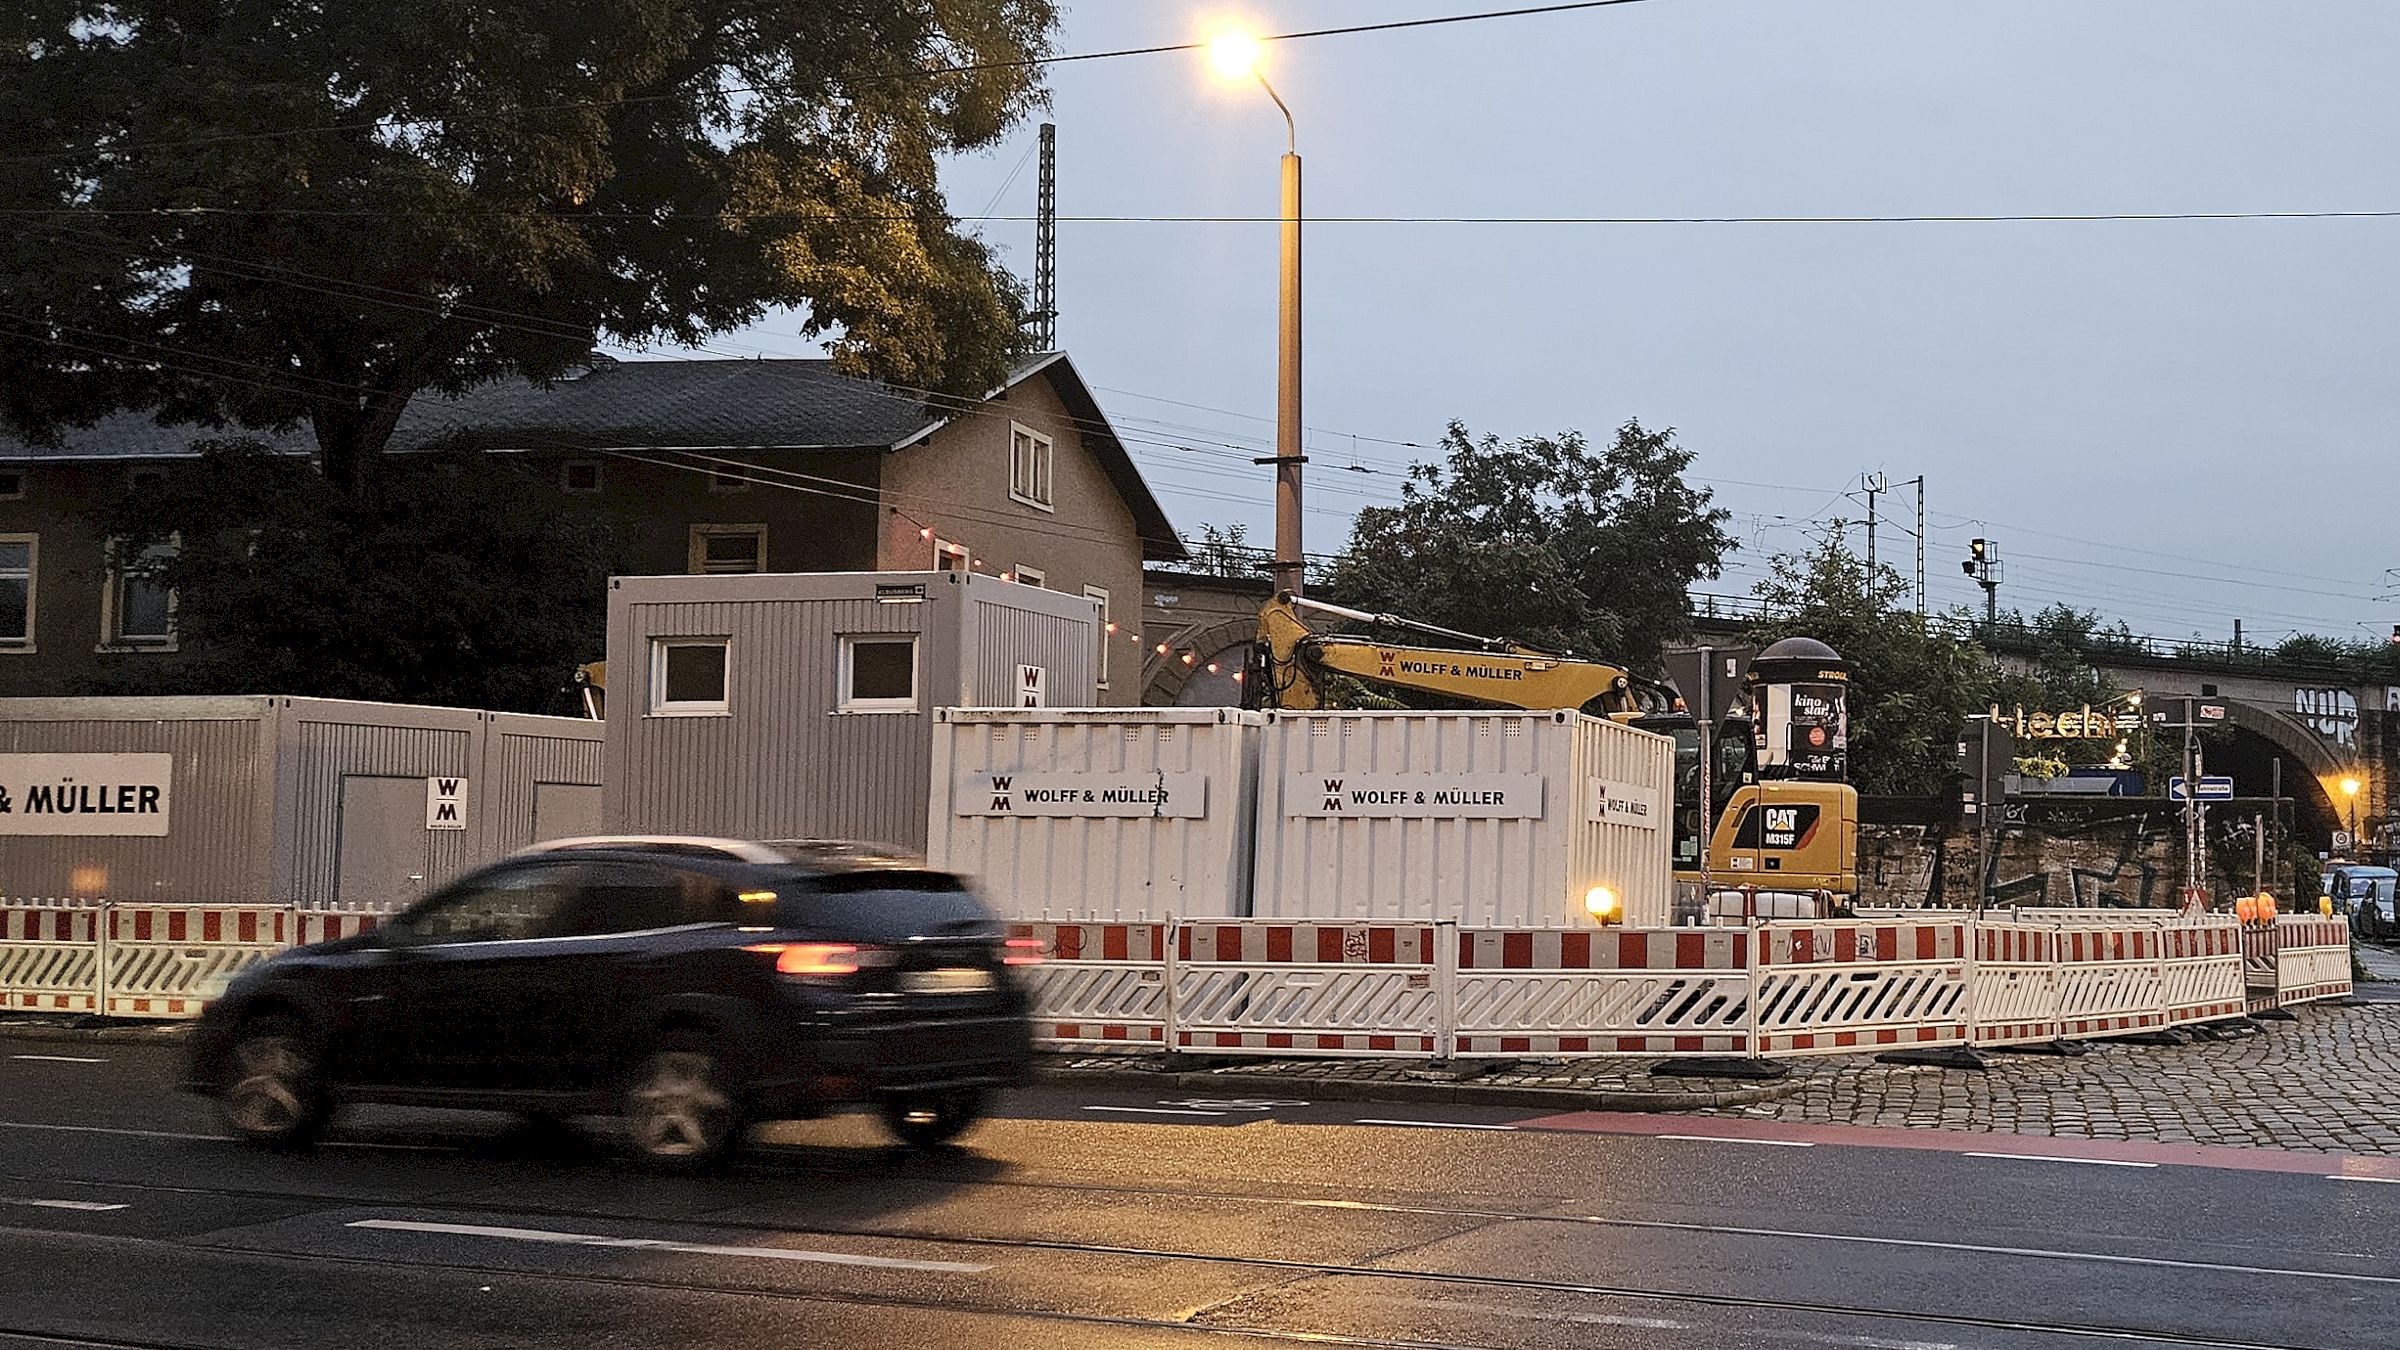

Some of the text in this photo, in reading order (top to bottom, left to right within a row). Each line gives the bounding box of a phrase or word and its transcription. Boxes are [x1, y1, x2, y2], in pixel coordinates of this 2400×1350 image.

[1381, 651, 1395, 662] W
[1024, 667, 1039, 687] W
[1380, 666, 1394, 677] M
[1400, 661, 1522, 680] WOLFF & MÜLLER
[1794, 694, 1822, 707] kino
[437, 779, 459, 796] W
[992, 776, 1013, 790] W
[1324, 779, 1344, 792] W
[24, 777, 160, 813] MÜLLER
[1024, 786, 1169, 803] WOLFF & MÜLLER
[1351, 787, 1504, 805] WOLFF & MÜLLER
[990, 797, 1011, 810] M
[1323, 798, 1342, 811] M
[436, 803, 457, 820] M
[1766, 808, 1798, 831] CAT
[1765, 833, 1795, 845] M315F
